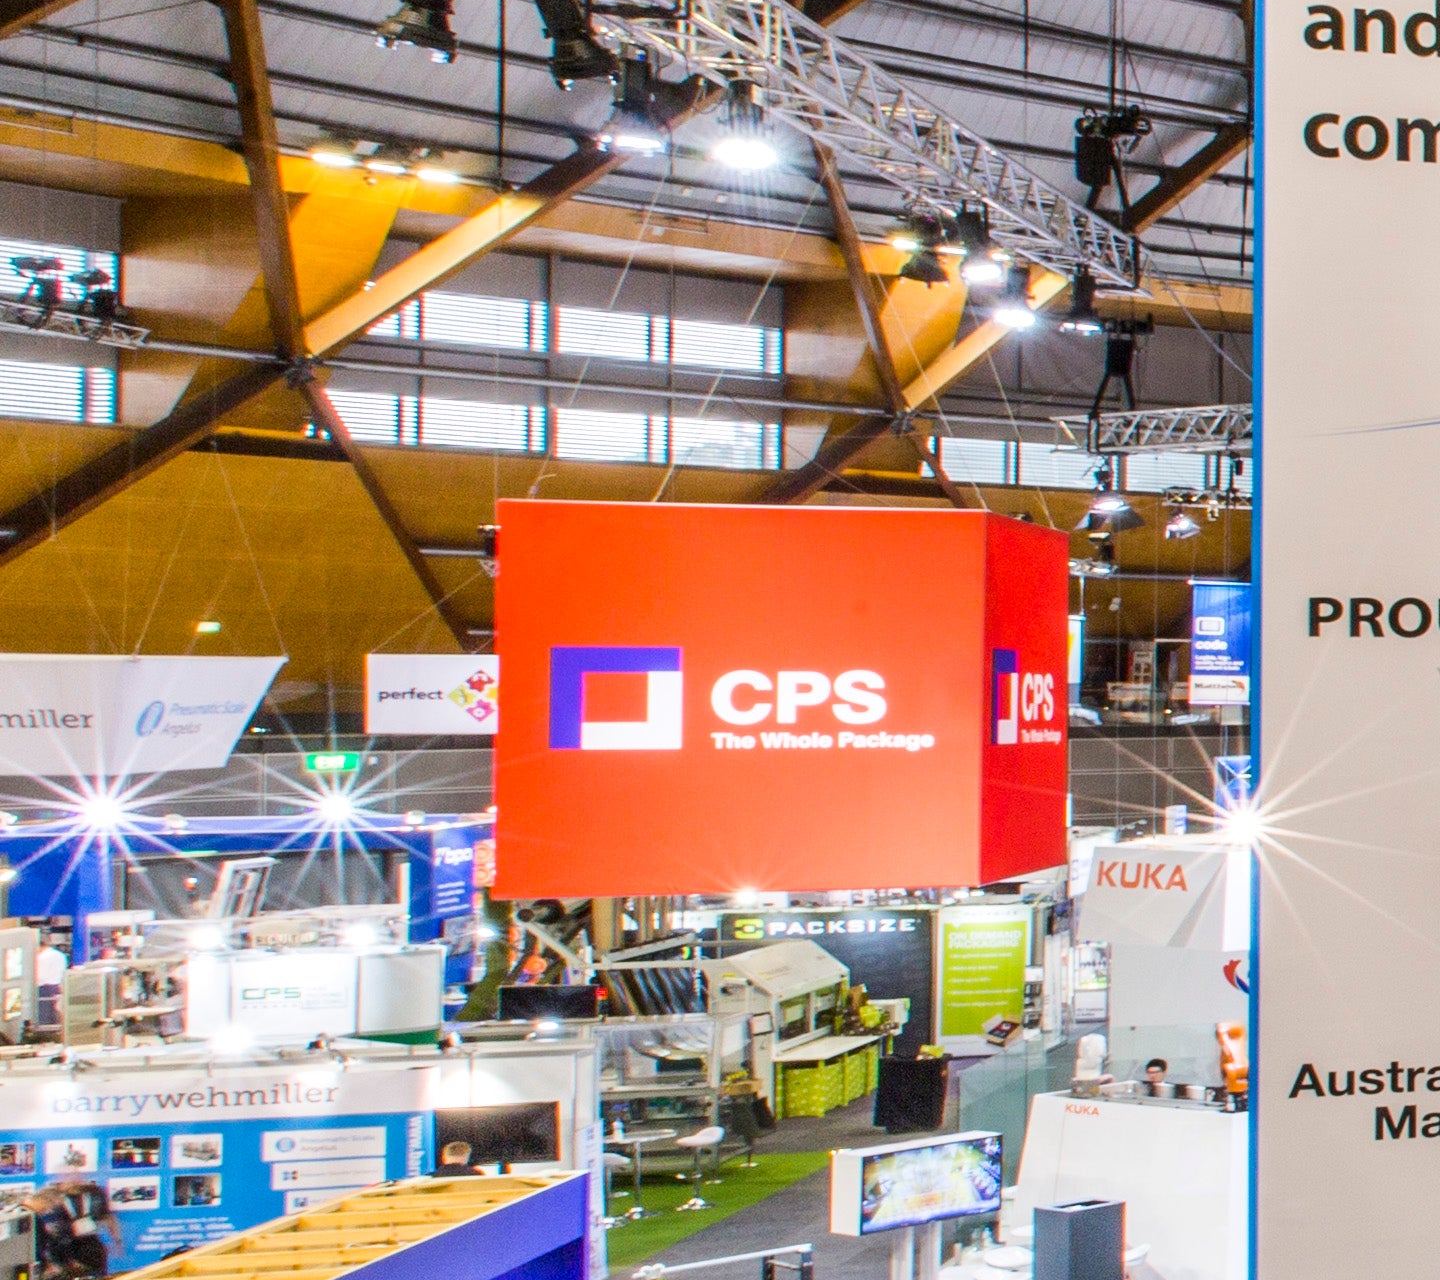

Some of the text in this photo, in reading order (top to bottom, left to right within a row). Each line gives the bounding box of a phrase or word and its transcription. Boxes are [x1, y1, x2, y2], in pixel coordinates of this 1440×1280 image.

[378, 687, 443, 702] perfect
[711, 670, 887, 724] CPS
[1022, 672, 1054, 721] CPS
[712, 732, 934, 751] The Whole Package
[1097, 859, 1188, 891] KUKA
[769, 918, 917, 937] PACKSIZE
[52, 1082, 339, 1117] barrywehmiller
[1065, 1103, 1099, 1116] KUKA
